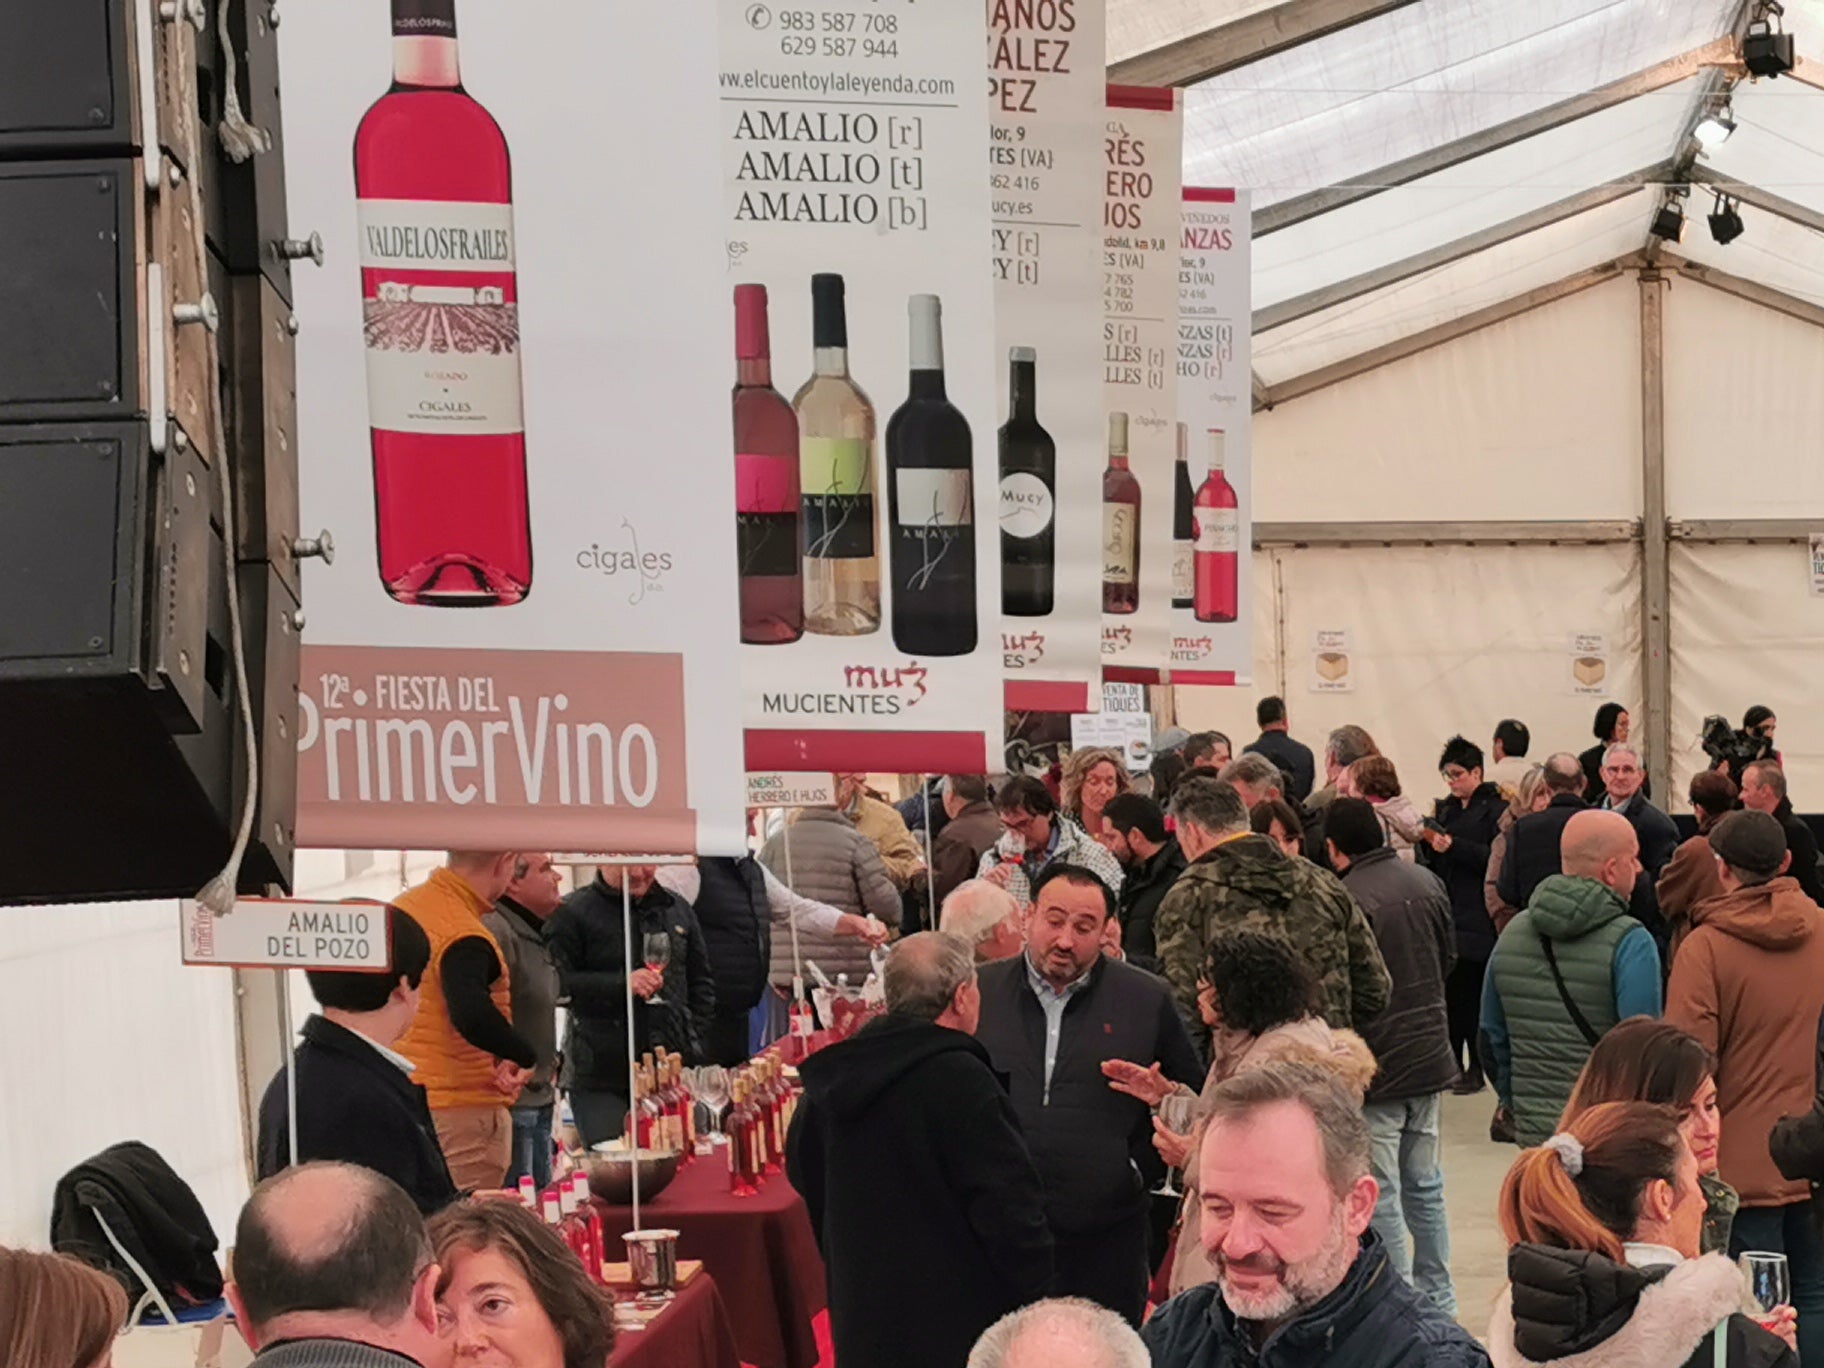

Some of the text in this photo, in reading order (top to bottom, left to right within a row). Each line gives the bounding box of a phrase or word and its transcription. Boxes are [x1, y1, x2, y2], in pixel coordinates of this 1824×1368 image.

[779, 11, 898, 34] 983 587 708
[780, 36, 899, 58] 629 587 944
[988, 27, 1071, 74] ÁLEZ
[733, 110, 923, 150] AMALIO [r]
[1016, 126, 1026, 141] 9
[735, 151, 923, 190] AMALIO [t]
[1014, 175, 1040, 191] 416
[734, 191, 927, 230] AMALIO [b]
[366, 225, 508, 262] VALDELOSFRAILES
[1017, 231, 1040, 257] [r]
[1017, 258, 1039, 285] [t]
[376, 675, 452, 711] FIESTA
[458, 676, 500, 712] DEL
[762, 693, 900, 715] MUCIENTES
[287, 911, 370, 935] AMALIO
[267, 936, 370, 960] DEL POZO
